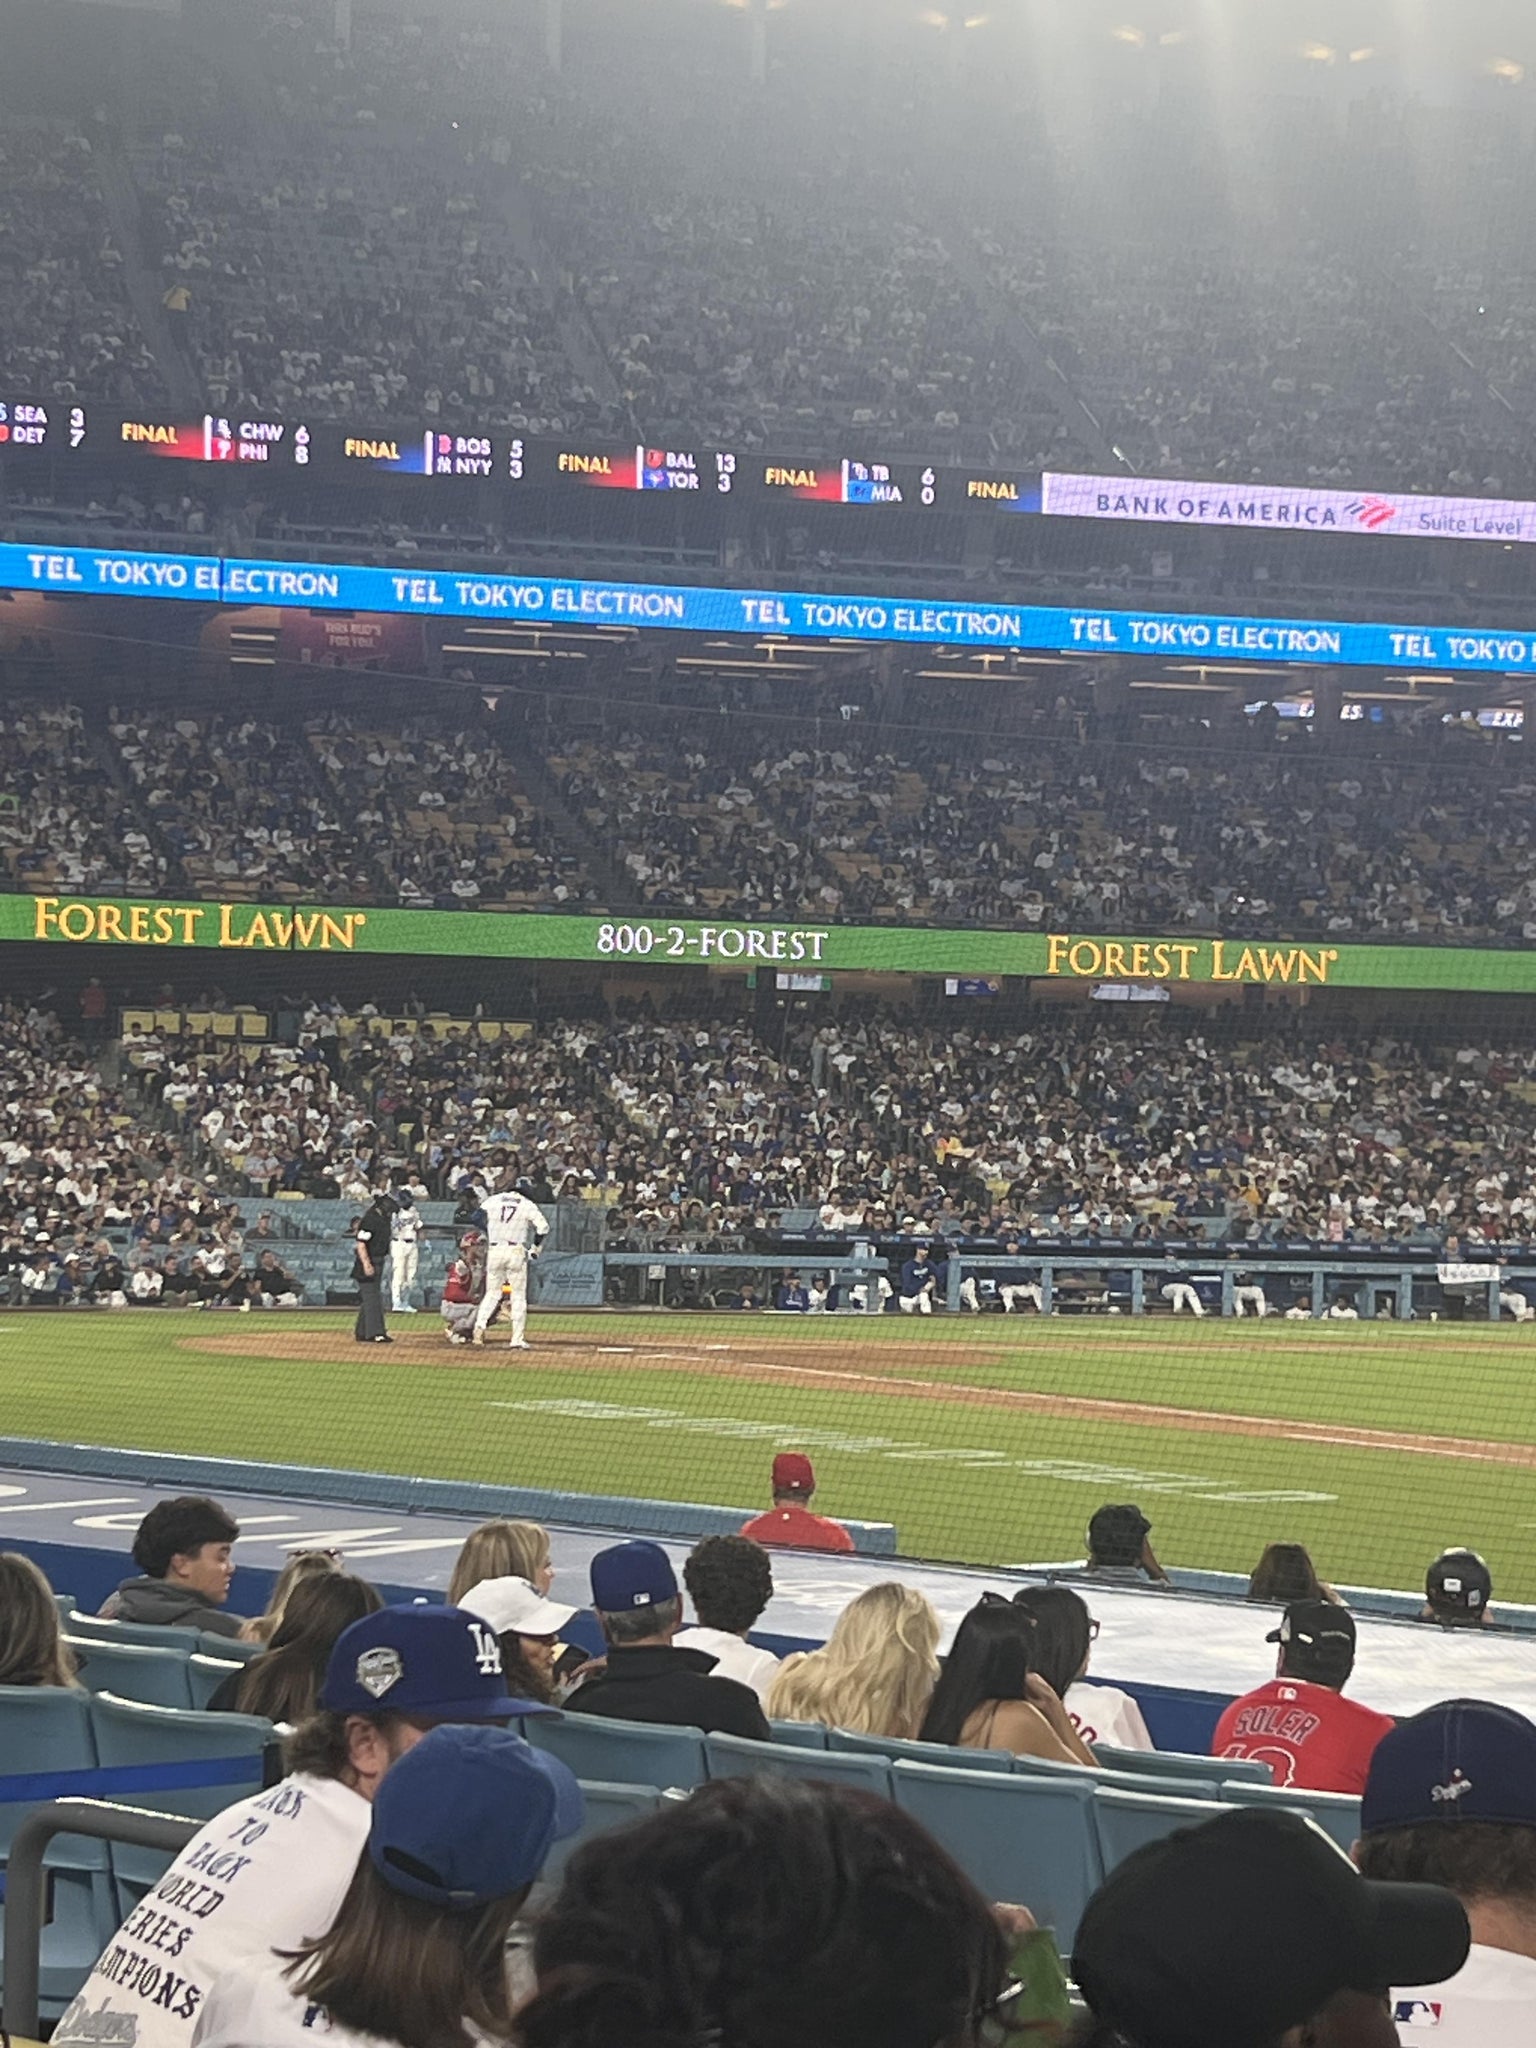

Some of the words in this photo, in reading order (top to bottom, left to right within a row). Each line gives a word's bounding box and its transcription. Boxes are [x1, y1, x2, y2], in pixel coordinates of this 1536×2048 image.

[14, 405, 48, 424] SEA
[70, 408, 84, 428] 3
[13, 425, 46, 444] DET
[70, 428, 86, 447] 7
[121, 422, 178, 445] FINAL
[239, 422, 284, 442] CHW
[295, 425, 310, 444] 6
[239, 442, 268, 461] PHI
[295, 445, 309, 464] 8
[345, 438, 400, 460] FINAL
[456, 436, 491, 456] BOS
[509, 439, 524, 459] 5
[456, 457, 493, 476] NYY
[509, 459, 523, 479] 3
[558, 453, 612, 474] FINAL
[666, 451, 697, 470] BAL
[715, 452, 736, 473] 13
[666, 471, 699, 490] TOR
[718, 473, 731, 493] 3
[765, 467, 817, 488] FINAL
[871, 464, 890, 482] TB
[921, 467, 935, 486] 6
[870, 485, 903, 502] MIA
[921, 486, 935, 505] 0
[967, 480, 1019, 501] FINAL
[1096, 493, 1168, 517] BANK
[1178, 499, 1208, 517] OF
[1216, 499, 1337, 527] AMERICA
[1419, 512, 1466, 534] Suite
[1473, 515, 1521, 536] Level
[28, 554, 82, 582] TEL
[94, 556, 187, 588] TOKYO
[195, 568, 339, 598] ELECTRON
[393, 576, 444, 604] TEL
[455, 580, 544, 611] TOKYO
[551, 586, 684, 618] ELECTRON
[742, 598, 791, 626] TEL
[802, 602, 886, 633] TOKYO
[894, 609, 1022, 638] ELECTRON
[1071, 617, 1118, 644] TEL
[1129, 620, 1210, 647] TOKYO
[1217, 627, 1341, 653] ELECTRON
[1389, 633, 1437, 658] TEL
[1447, 636, 1526, 662] TOKYO
[34, 896, 204, 944] FOREST
[596, 923, 830, 961] 800-2-FOREST
[1046, 933, 1198, 979] FOREST
[501, 1205, 518, 1223] 17
[466, 1622, 502, 1675] LA
[1233, 1704, 1321, 1746] SOLER
[253, 1783, 308, 1820] ACK
[229, 1816, 269, 1846] TO
[149, 1872, 226, 1919] ORLD
